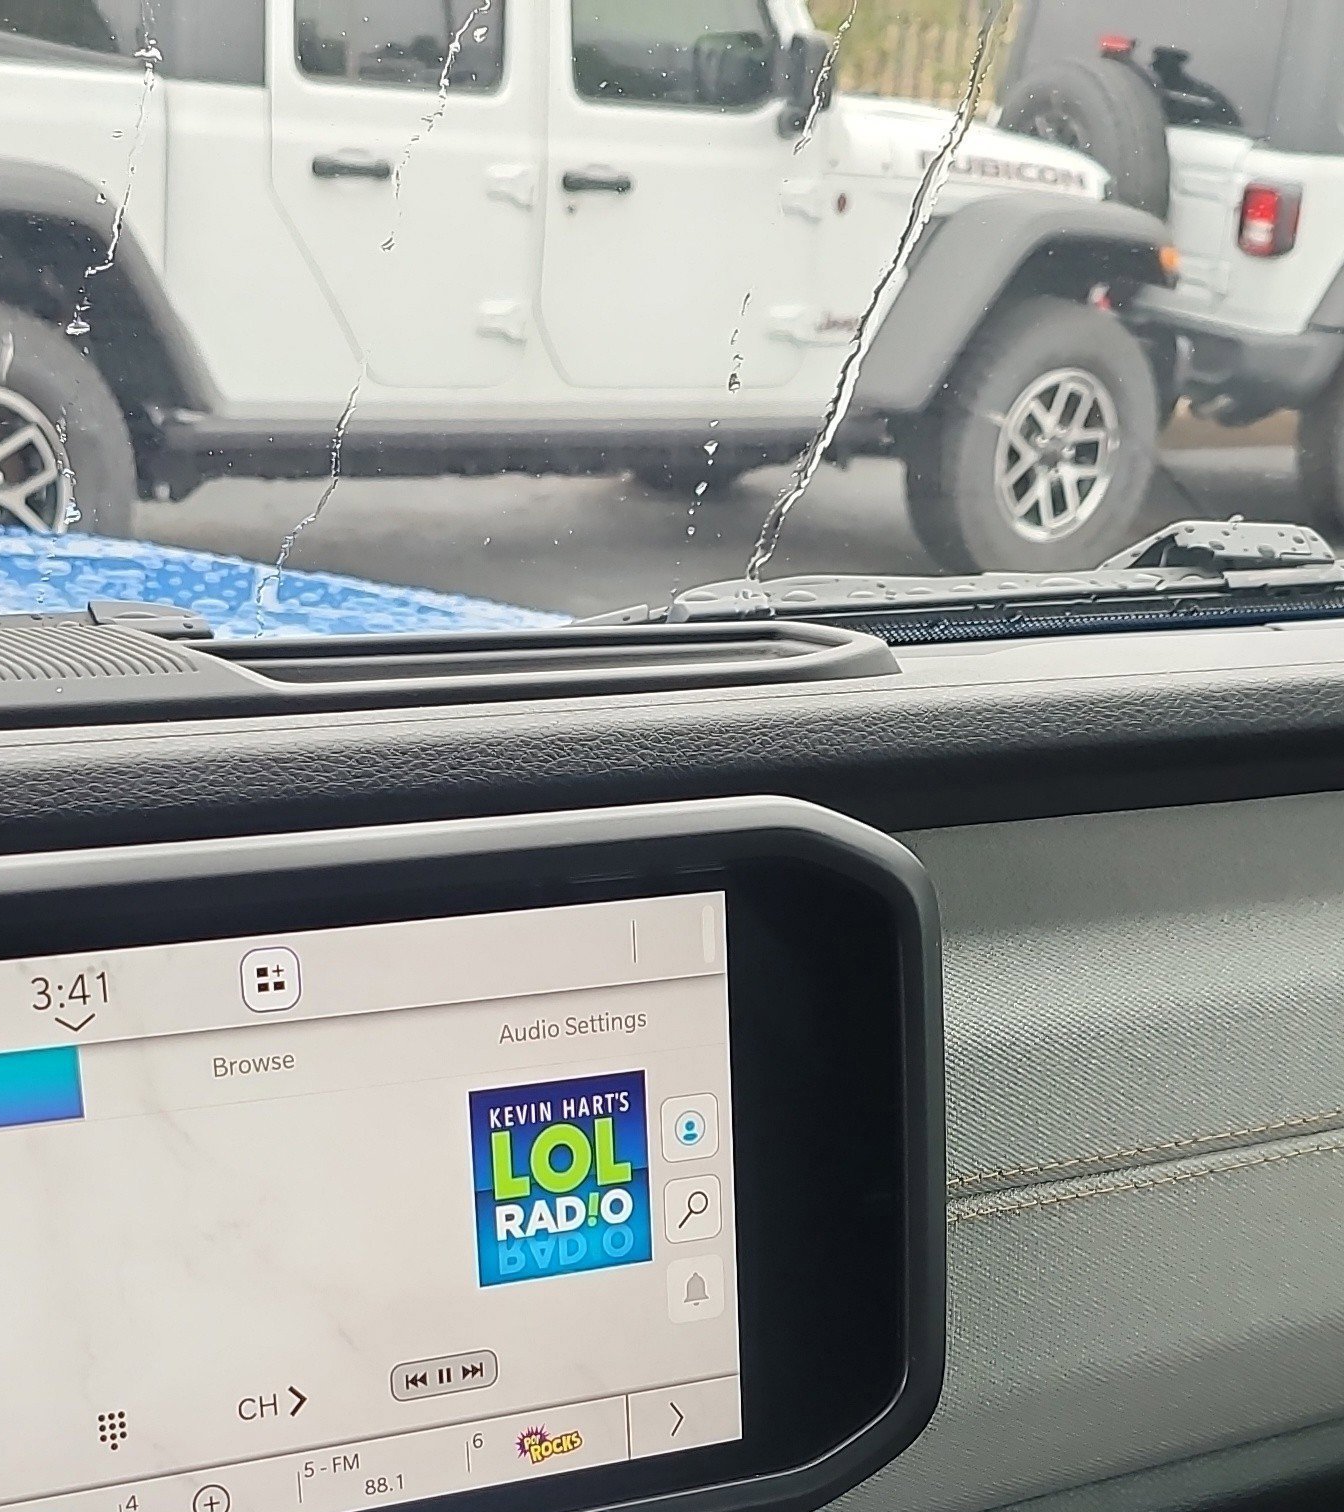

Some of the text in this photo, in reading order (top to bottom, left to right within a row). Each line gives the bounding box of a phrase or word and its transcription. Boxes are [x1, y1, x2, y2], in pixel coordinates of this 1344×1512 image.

[30, 971, 109, 1011] 3:41
[499, 1012, 647, 1044] Audio Settings
[212, 1051, 295, 1078] Browse
[490, 1091, 630, 1128] KEVIN HART'S
[491, 1117, 632, 1201] LOL
[238, 1393, 279, 1421] CH
[473, 1432, 483, 1449] 6
[530, 1431, 582, 1463] ROCKS
[304, 1461, 315, 1477] 5
[332, 1453, 360, 1474] FM
[365, 1474, 404, 1495] 88.1
[125, 1495, 139, 1512] 4
